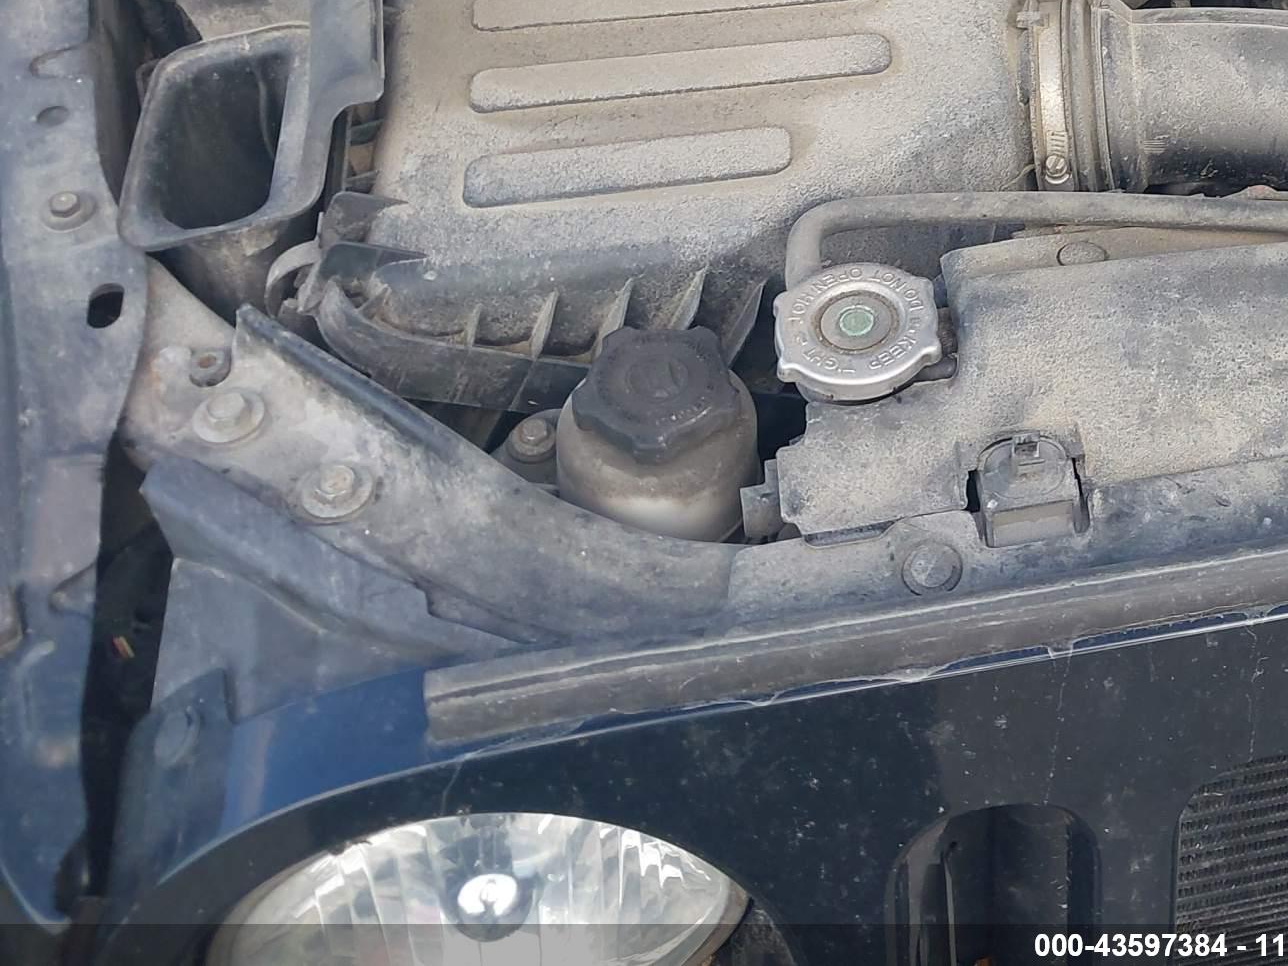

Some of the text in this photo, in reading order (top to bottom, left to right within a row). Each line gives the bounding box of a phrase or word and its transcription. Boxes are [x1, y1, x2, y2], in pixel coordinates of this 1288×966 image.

[813, 267, 863, 295] OPEN
[869, 269, 908, 292] NOT
[903, 288, 924, 312] DO
[868, 336, 917, 371] KEEP
